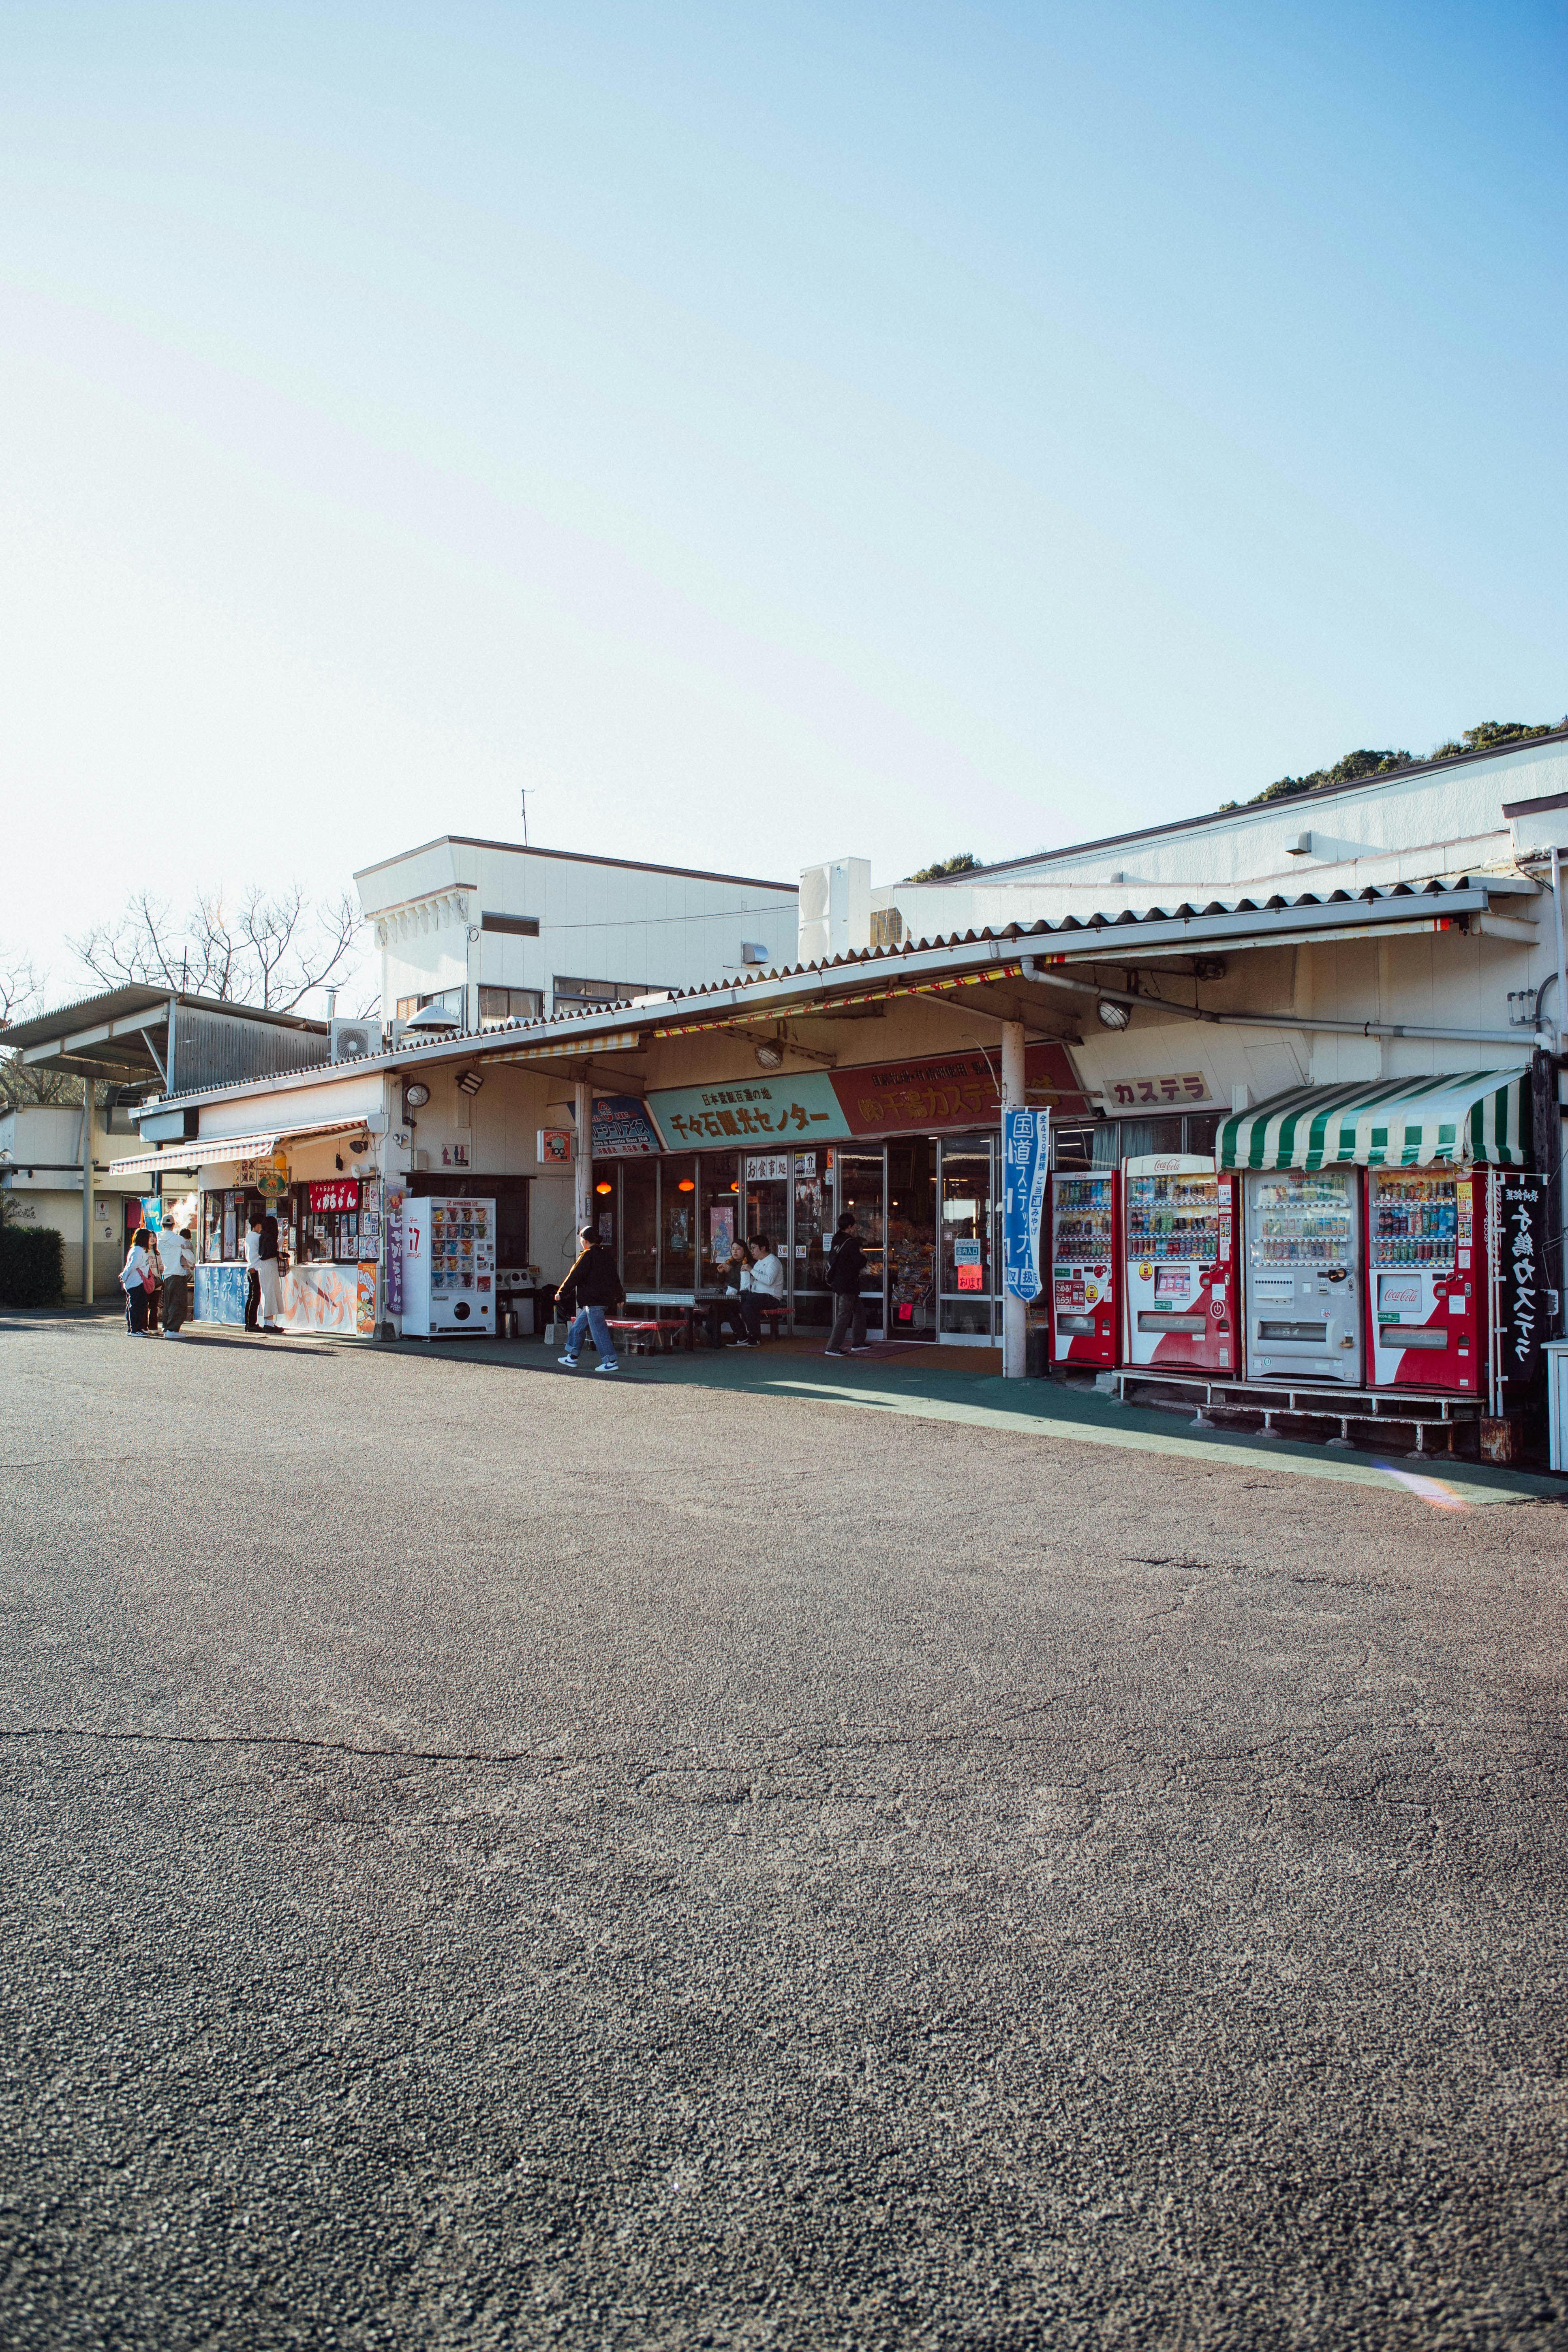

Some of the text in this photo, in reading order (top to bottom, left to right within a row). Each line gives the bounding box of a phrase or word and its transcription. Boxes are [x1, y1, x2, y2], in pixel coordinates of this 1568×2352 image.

[1114, 1077, 1204, 1104] カステラ
[552, 1147, 565, 1155] 100
[1037, 1115, 1047, 1171] 全459種類
[748, 1159, 787, 1178] お食事処
[1155, 1159, 1180, 1171] Coca-Cola
[1013, 1114, 1033, 1268] 国道ステッカー
[1384, 1288, 1419, 1302] Coca-Cola
